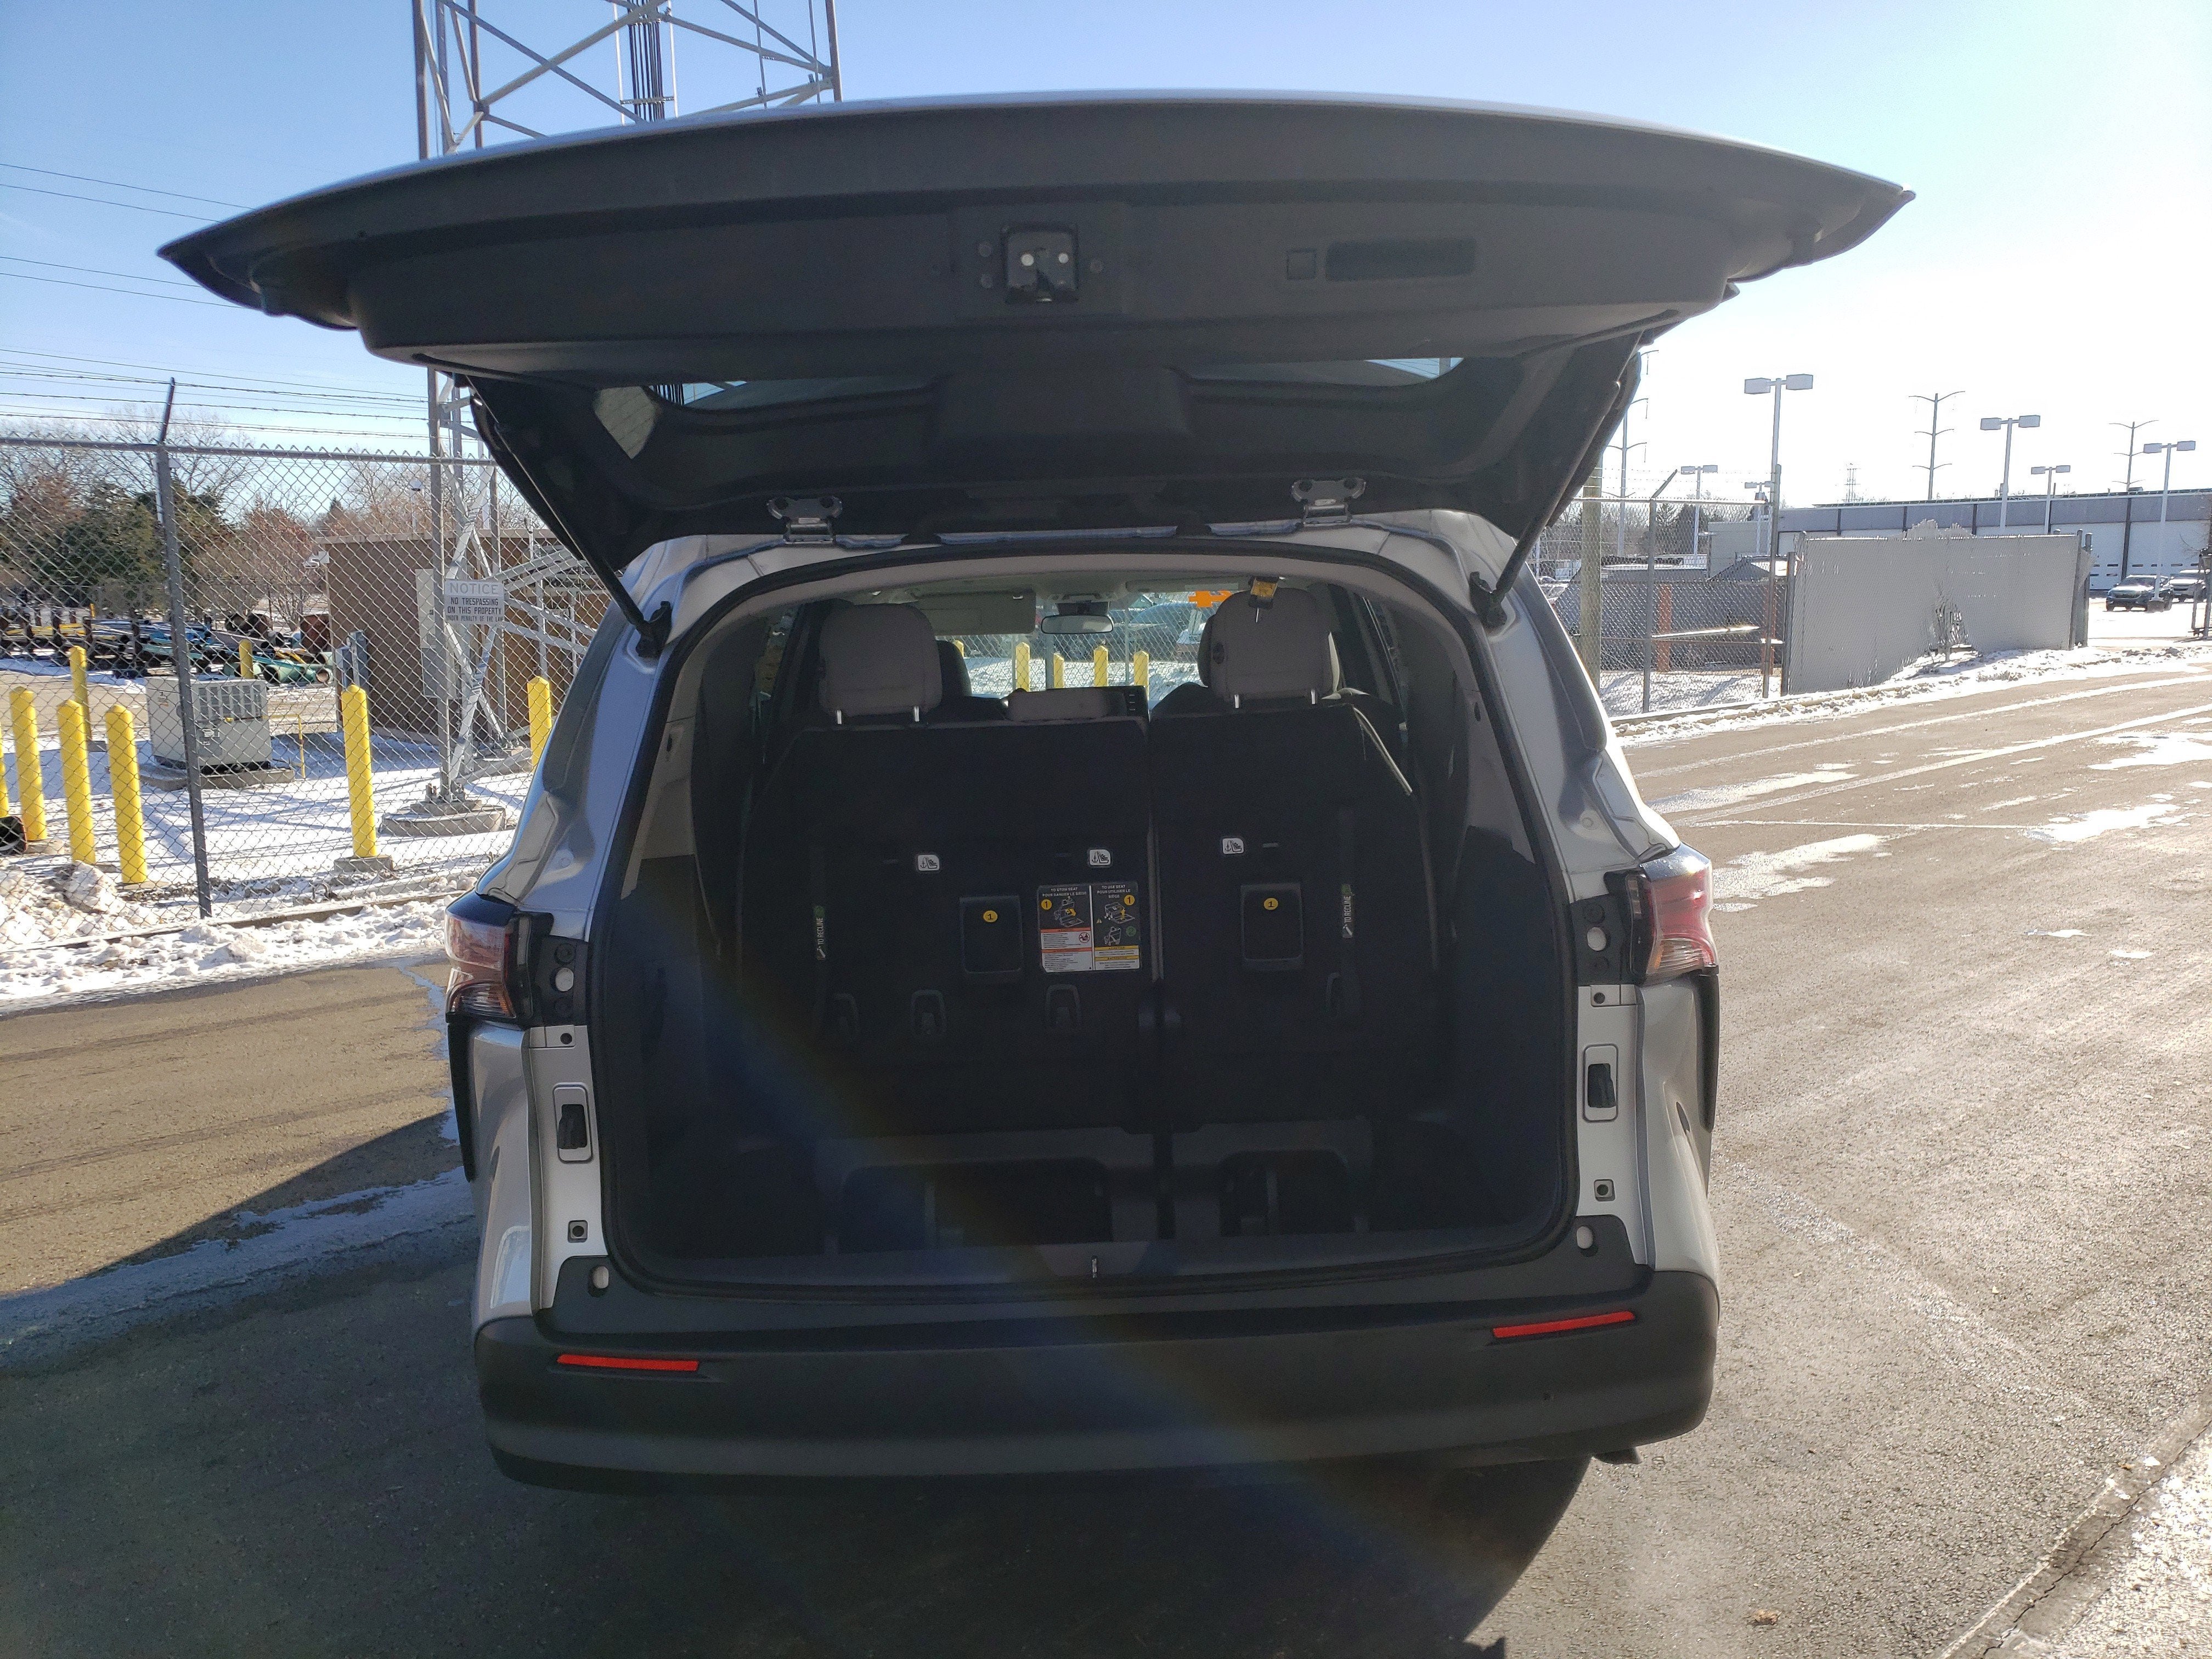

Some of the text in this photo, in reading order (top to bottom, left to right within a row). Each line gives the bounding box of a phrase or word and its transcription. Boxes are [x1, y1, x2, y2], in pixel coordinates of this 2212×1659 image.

[449, 582, 499, 595] NOTICE
[450, 597, 499, 606] NO TRESPASSING
[447, 606, 455, 614] ON
